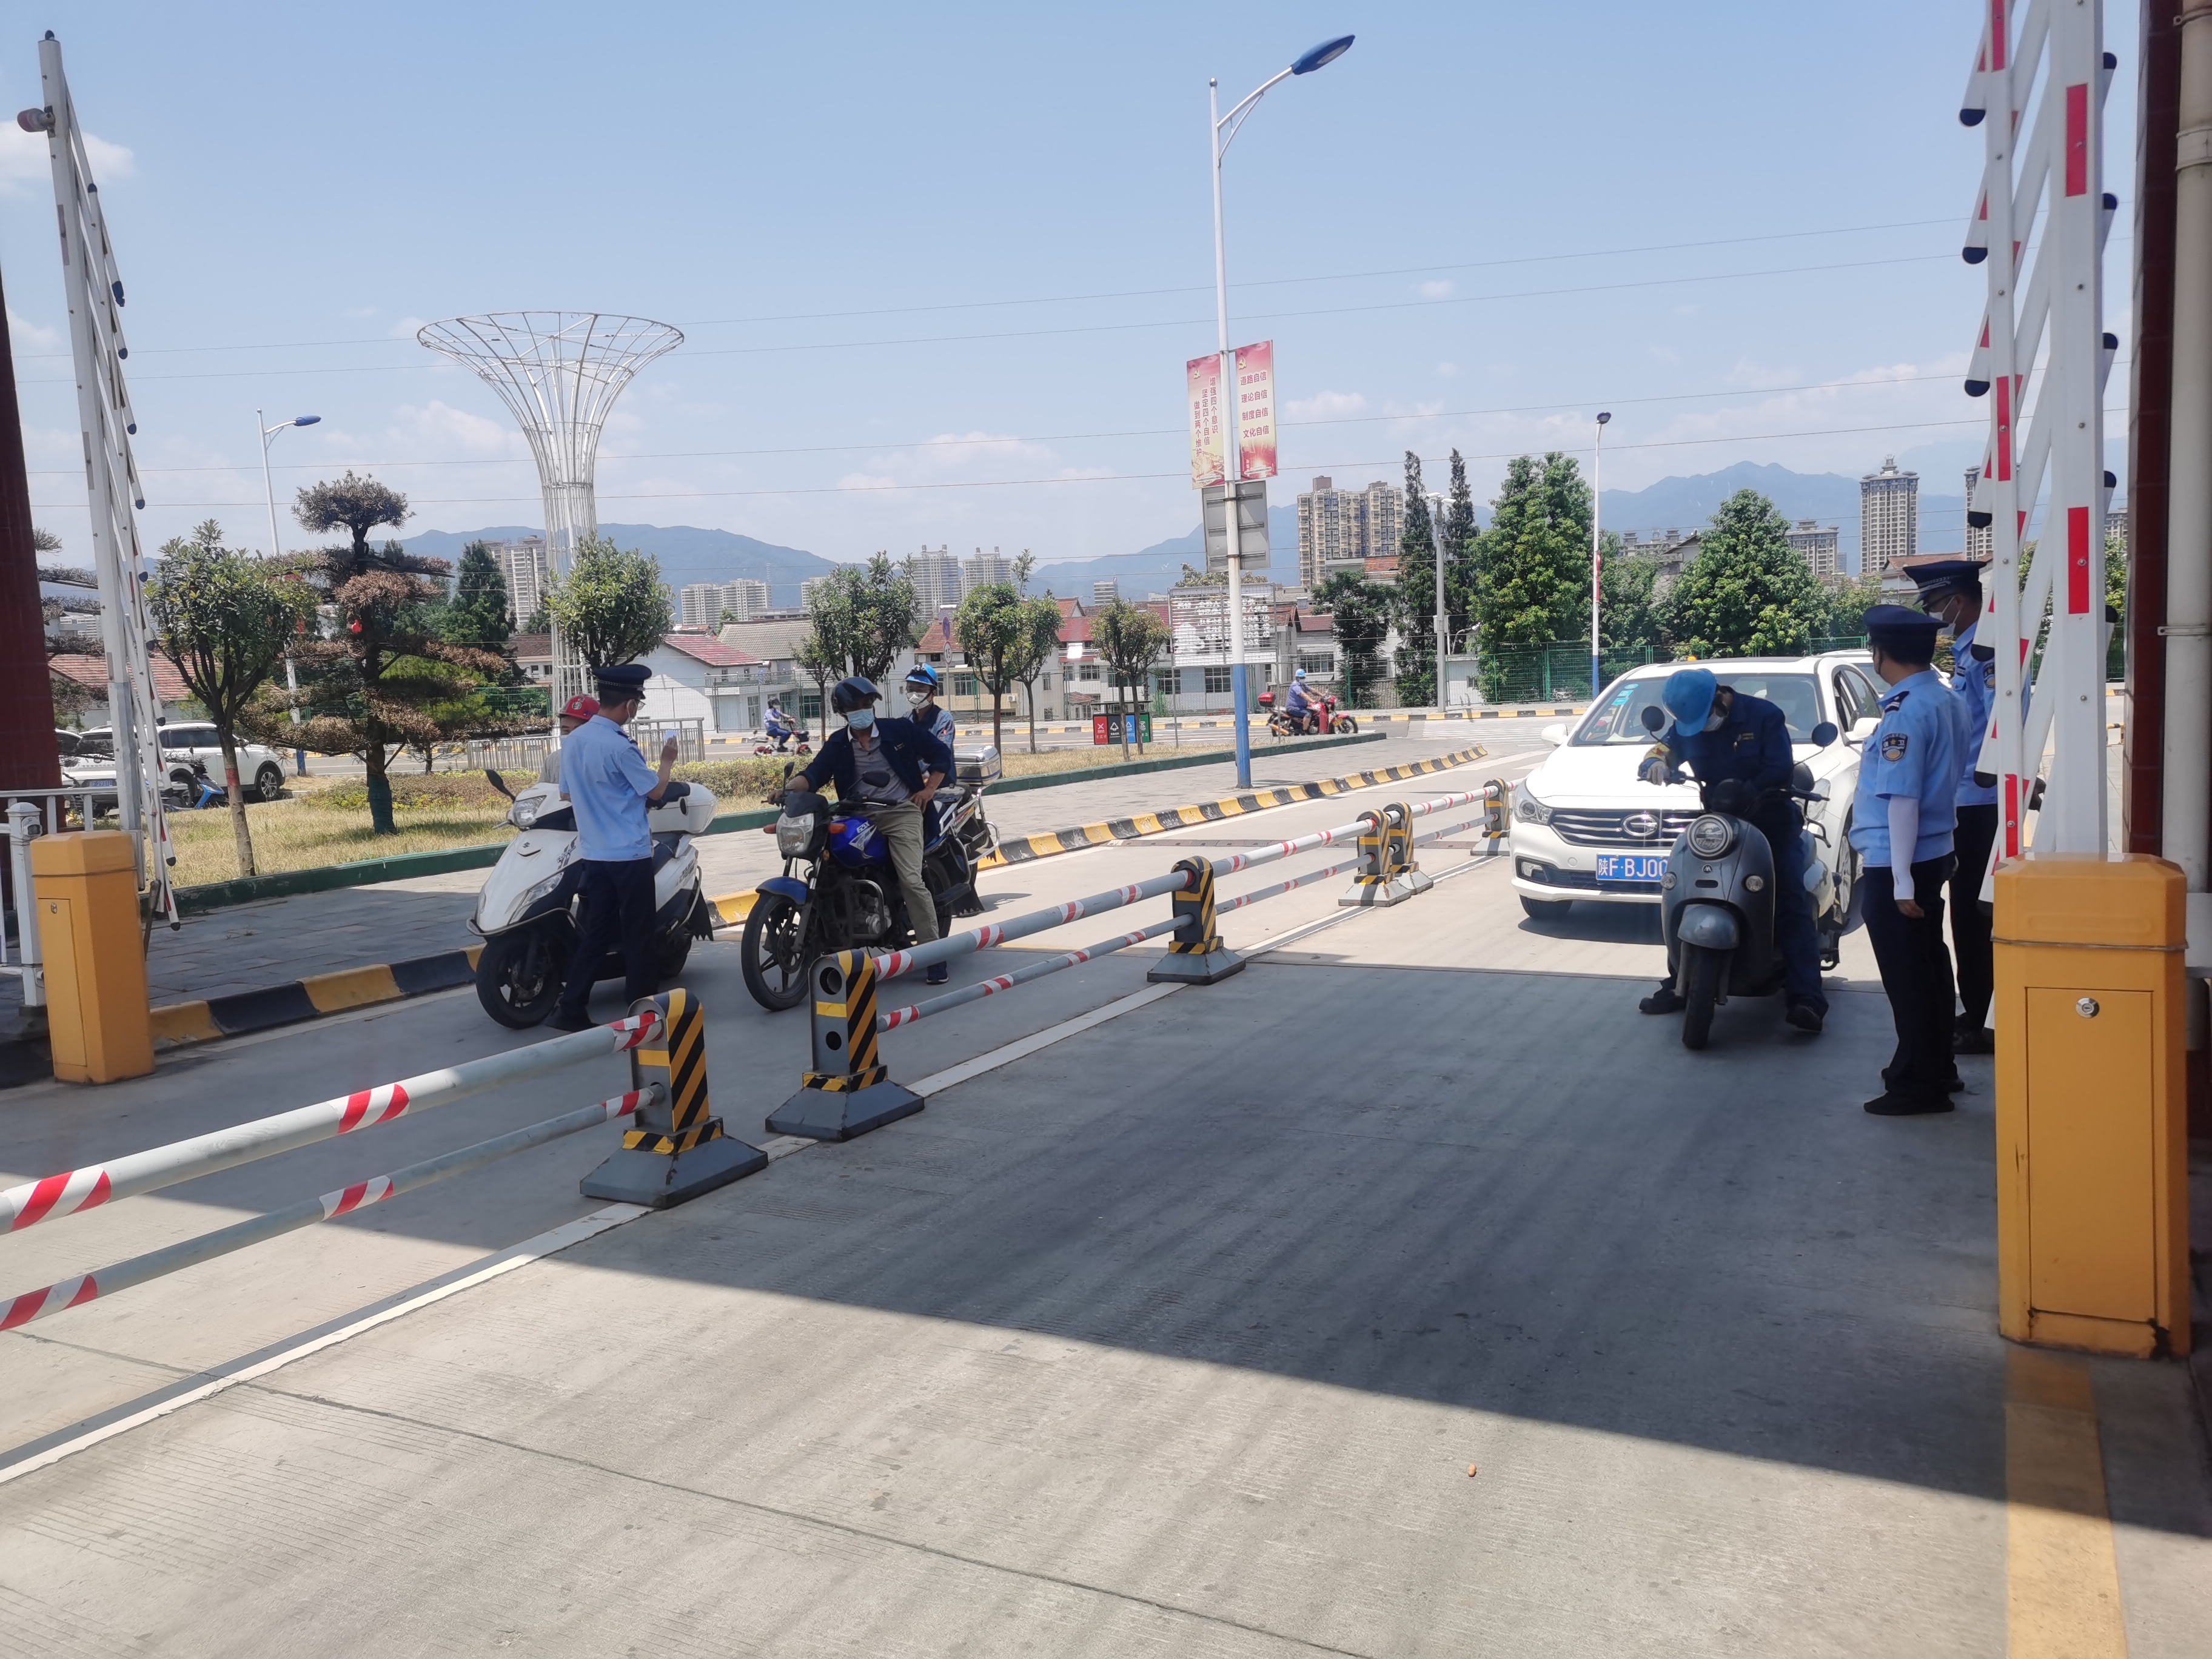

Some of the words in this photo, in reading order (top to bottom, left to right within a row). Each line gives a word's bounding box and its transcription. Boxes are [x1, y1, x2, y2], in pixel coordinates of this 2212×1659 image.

[1240, 371, 1267, 386] 道路自信
[1241, 389, 1267, 403] 理论自信
[1210, 377, 1219, 434] 增强四个意识
[1202, 388, 1210, 446] 坚定四个自信
[1242, 407, 1269, 421] 制度自信
[1243, 424, 1269, 438] 文化自信
[945, 648, 951, 659] 15
